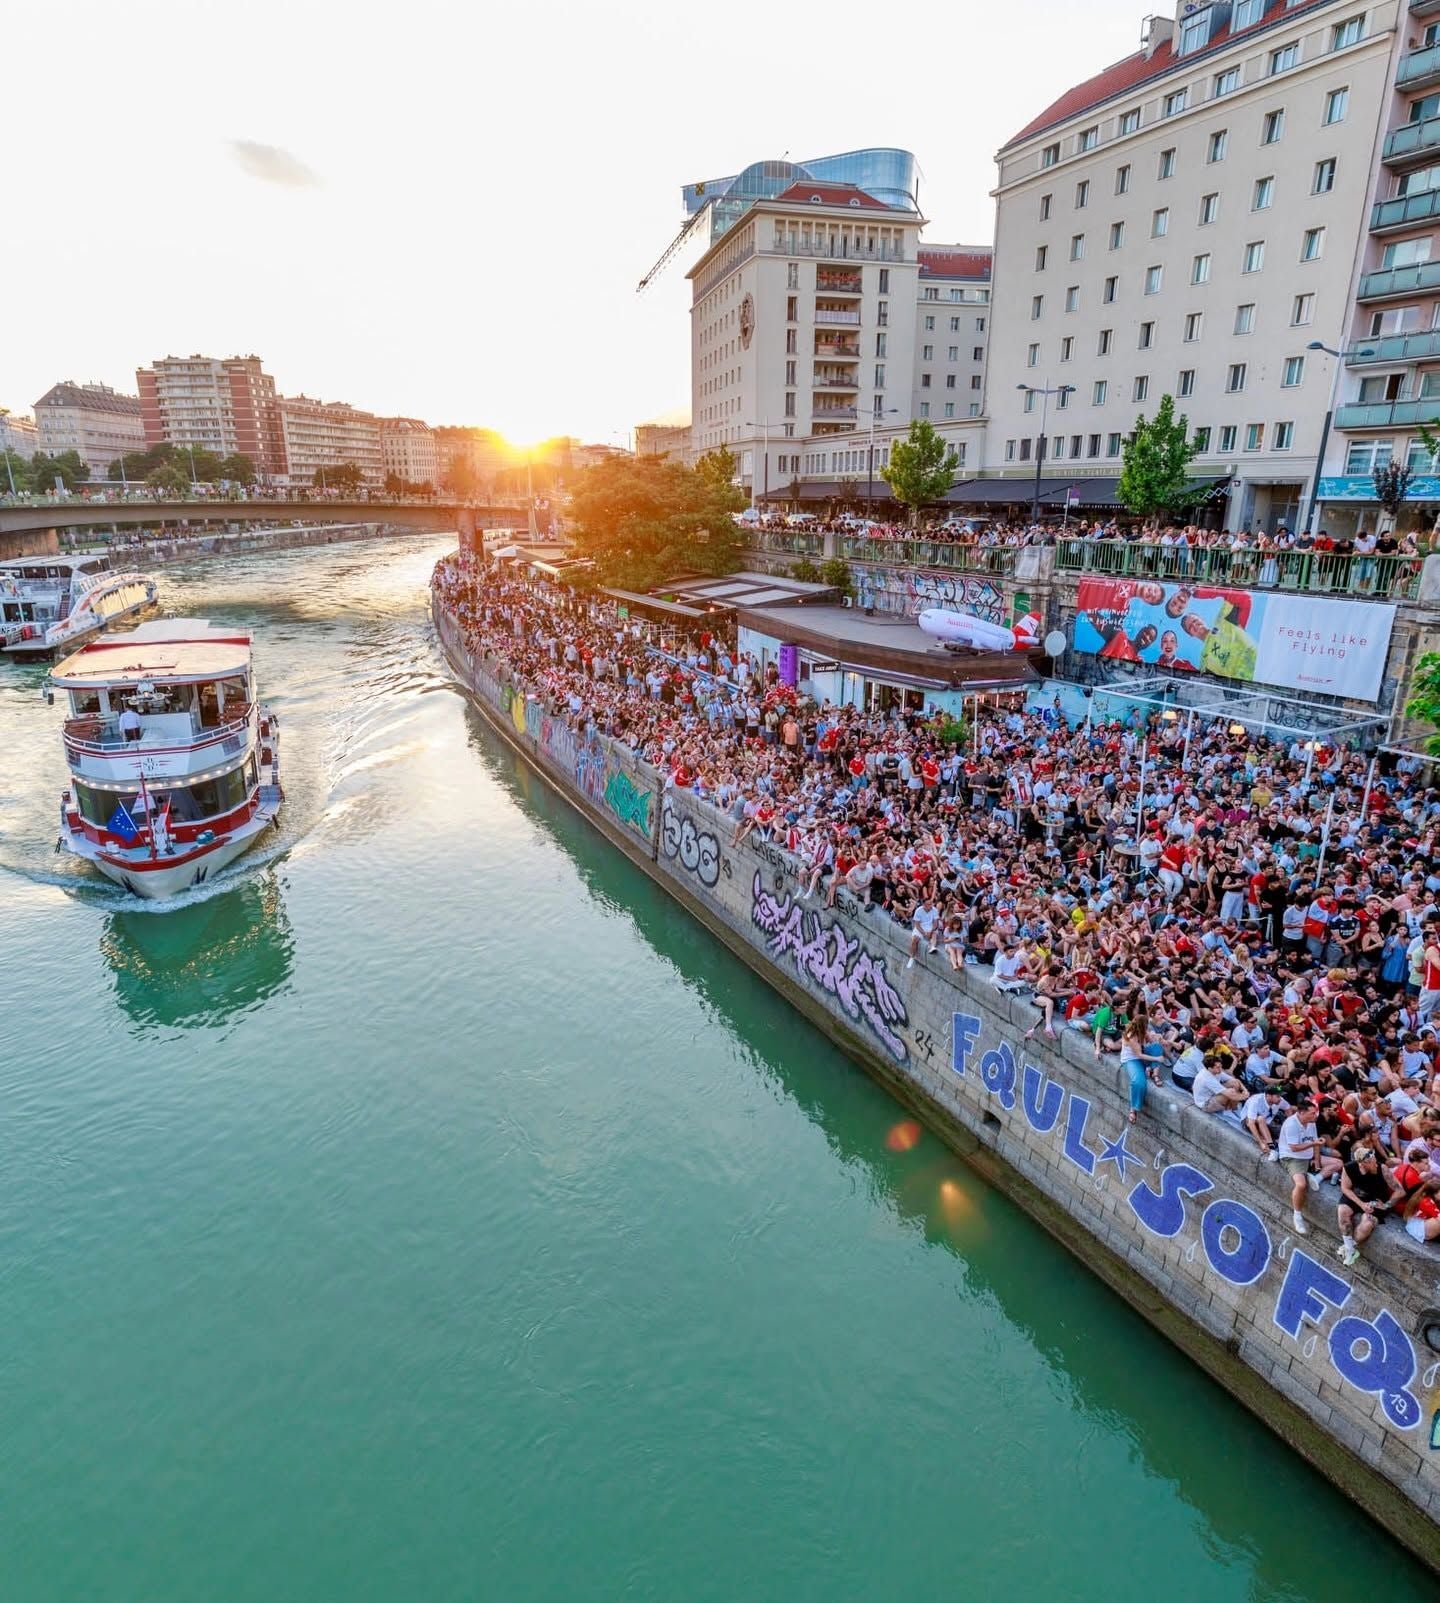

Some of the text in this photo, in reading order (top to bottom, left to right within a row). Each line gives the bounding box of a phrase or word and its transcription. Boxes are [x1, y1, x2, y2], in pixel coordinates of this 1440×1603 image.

[1279, 626, 1367, 646] Feels like
[1292, 641, 1346, 659] Flying
[915, 1029, 935, 1061] 24
